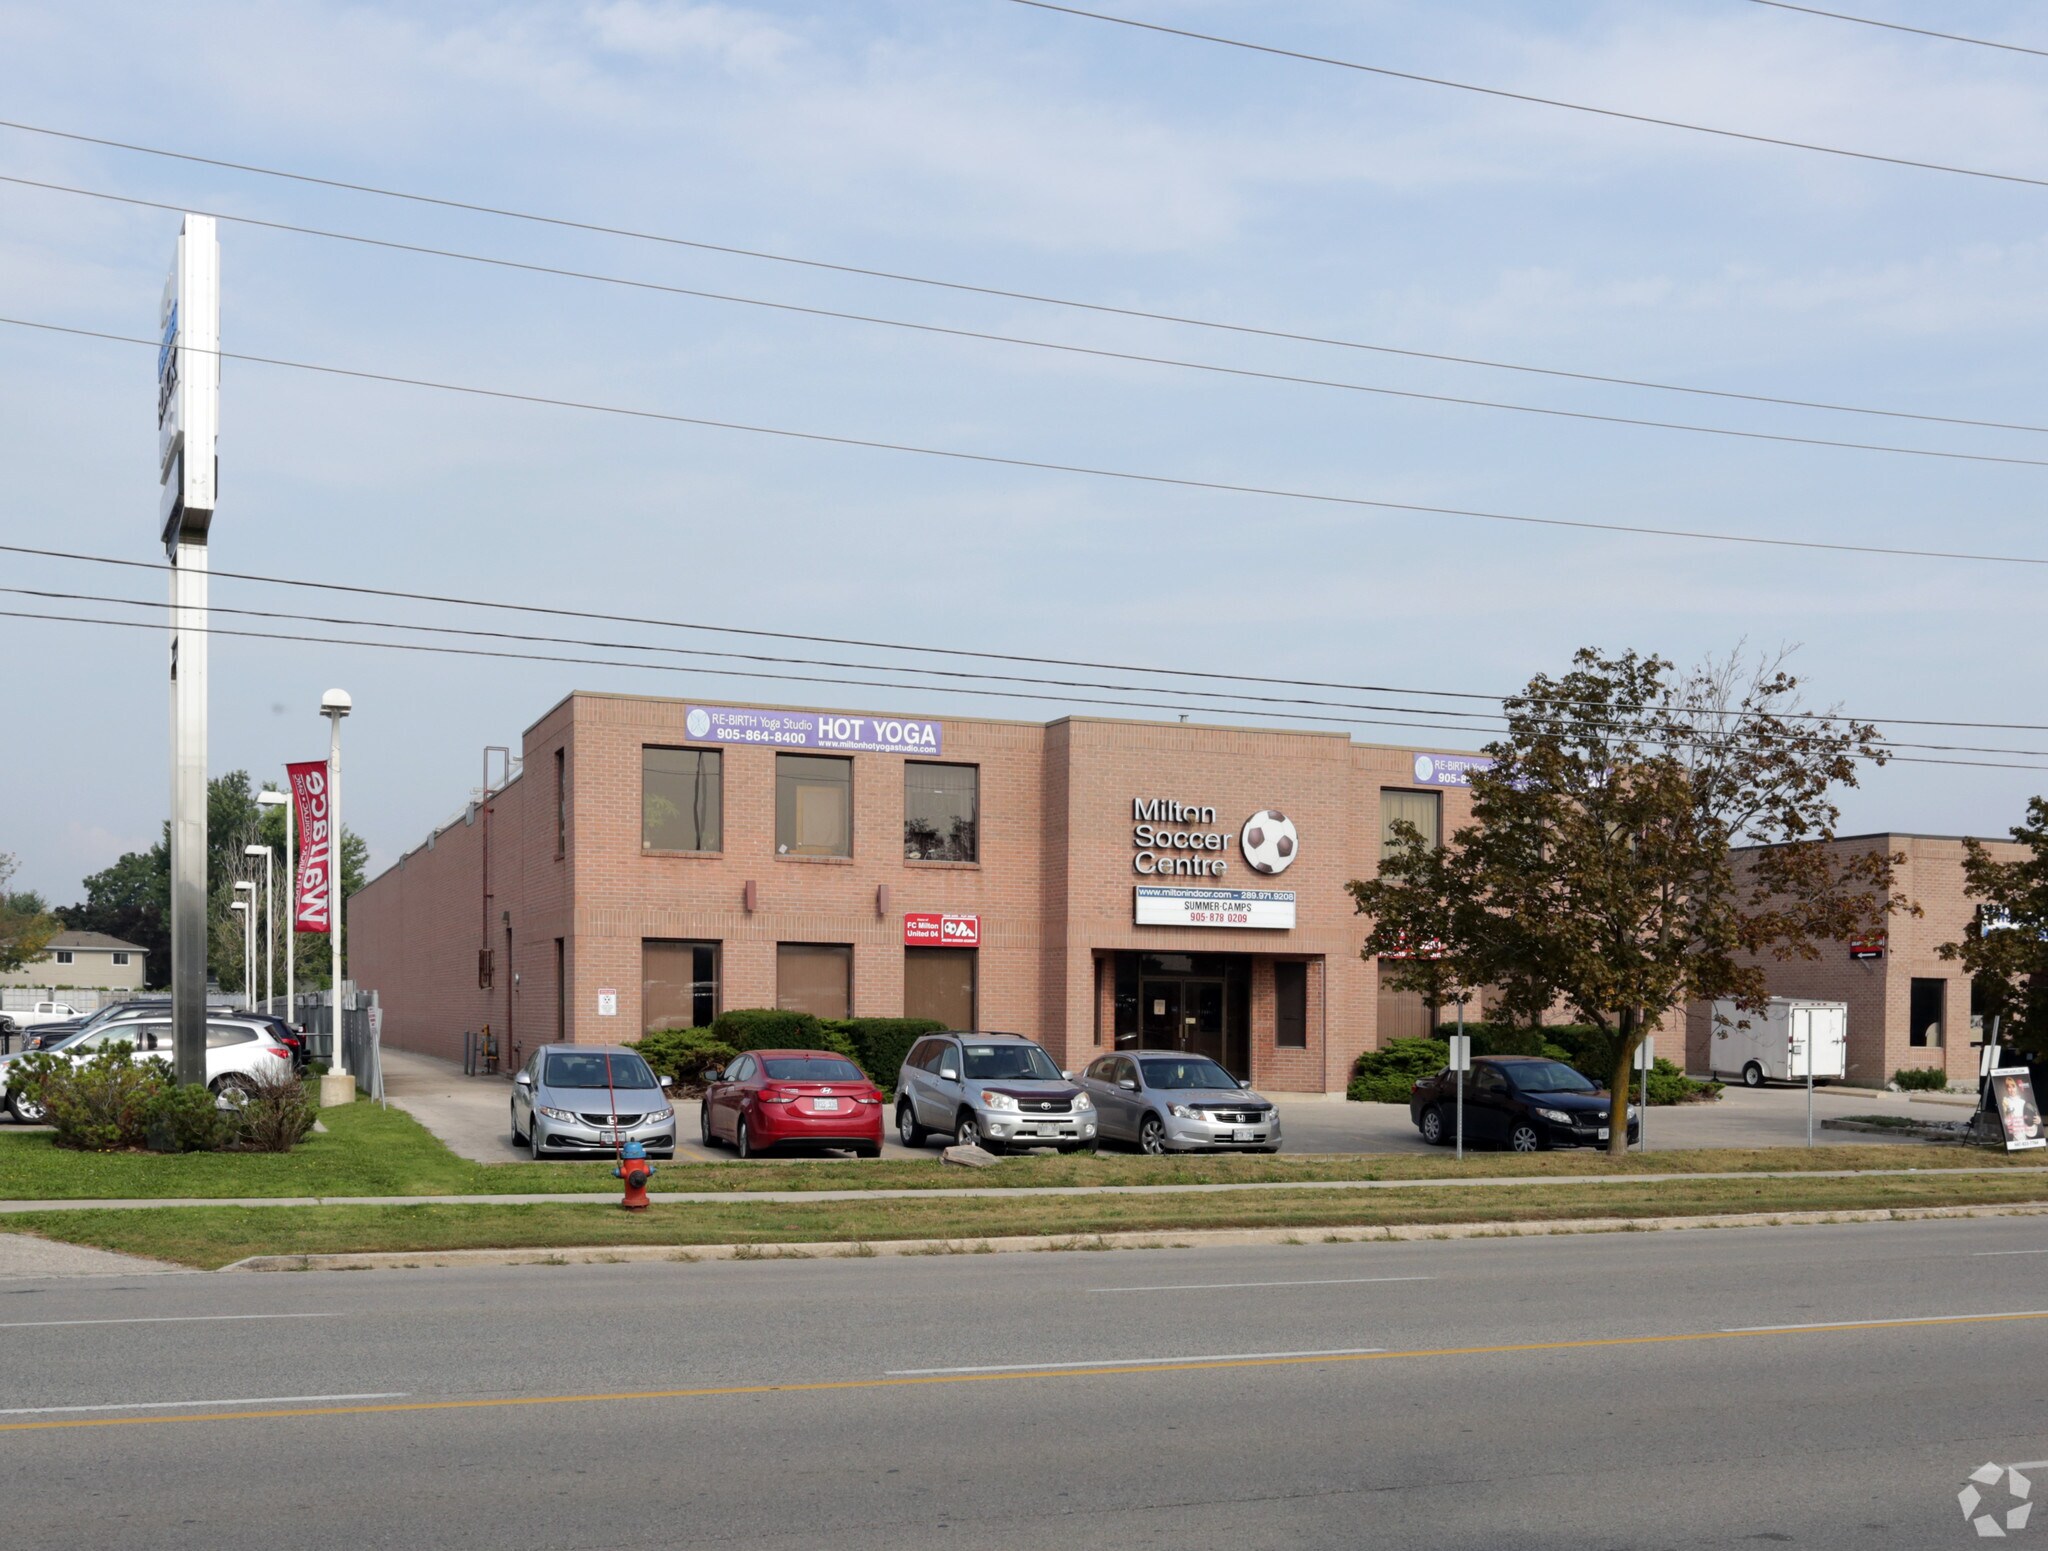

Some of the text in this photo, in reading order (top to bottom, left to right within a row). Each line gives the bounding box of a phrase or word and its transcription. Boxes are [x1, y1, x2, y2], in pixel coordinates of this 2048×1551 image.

[712, 713, 813, 732] RE-BIRTH Yoga Studio
[818, 717, 936, 745] HOT YOGA
[717, 728, 806, 744] 905-864-8400
[818, 740, 937, 753] www.miltonhotyogastudio.com
[1434, 760, 1470, 771] RE-BIRTH
[1134, 797, 1217, 823] Milton
[1134, 825, 1232, 850] Soccer
[1134, 851, 1228, 876] Centre
[1138, 888, 1232, 899] www.miltonindoor.com
[1241, 891, 1294, 901] 289.971.9208
[1228, 913, 1248, 923] 0209
